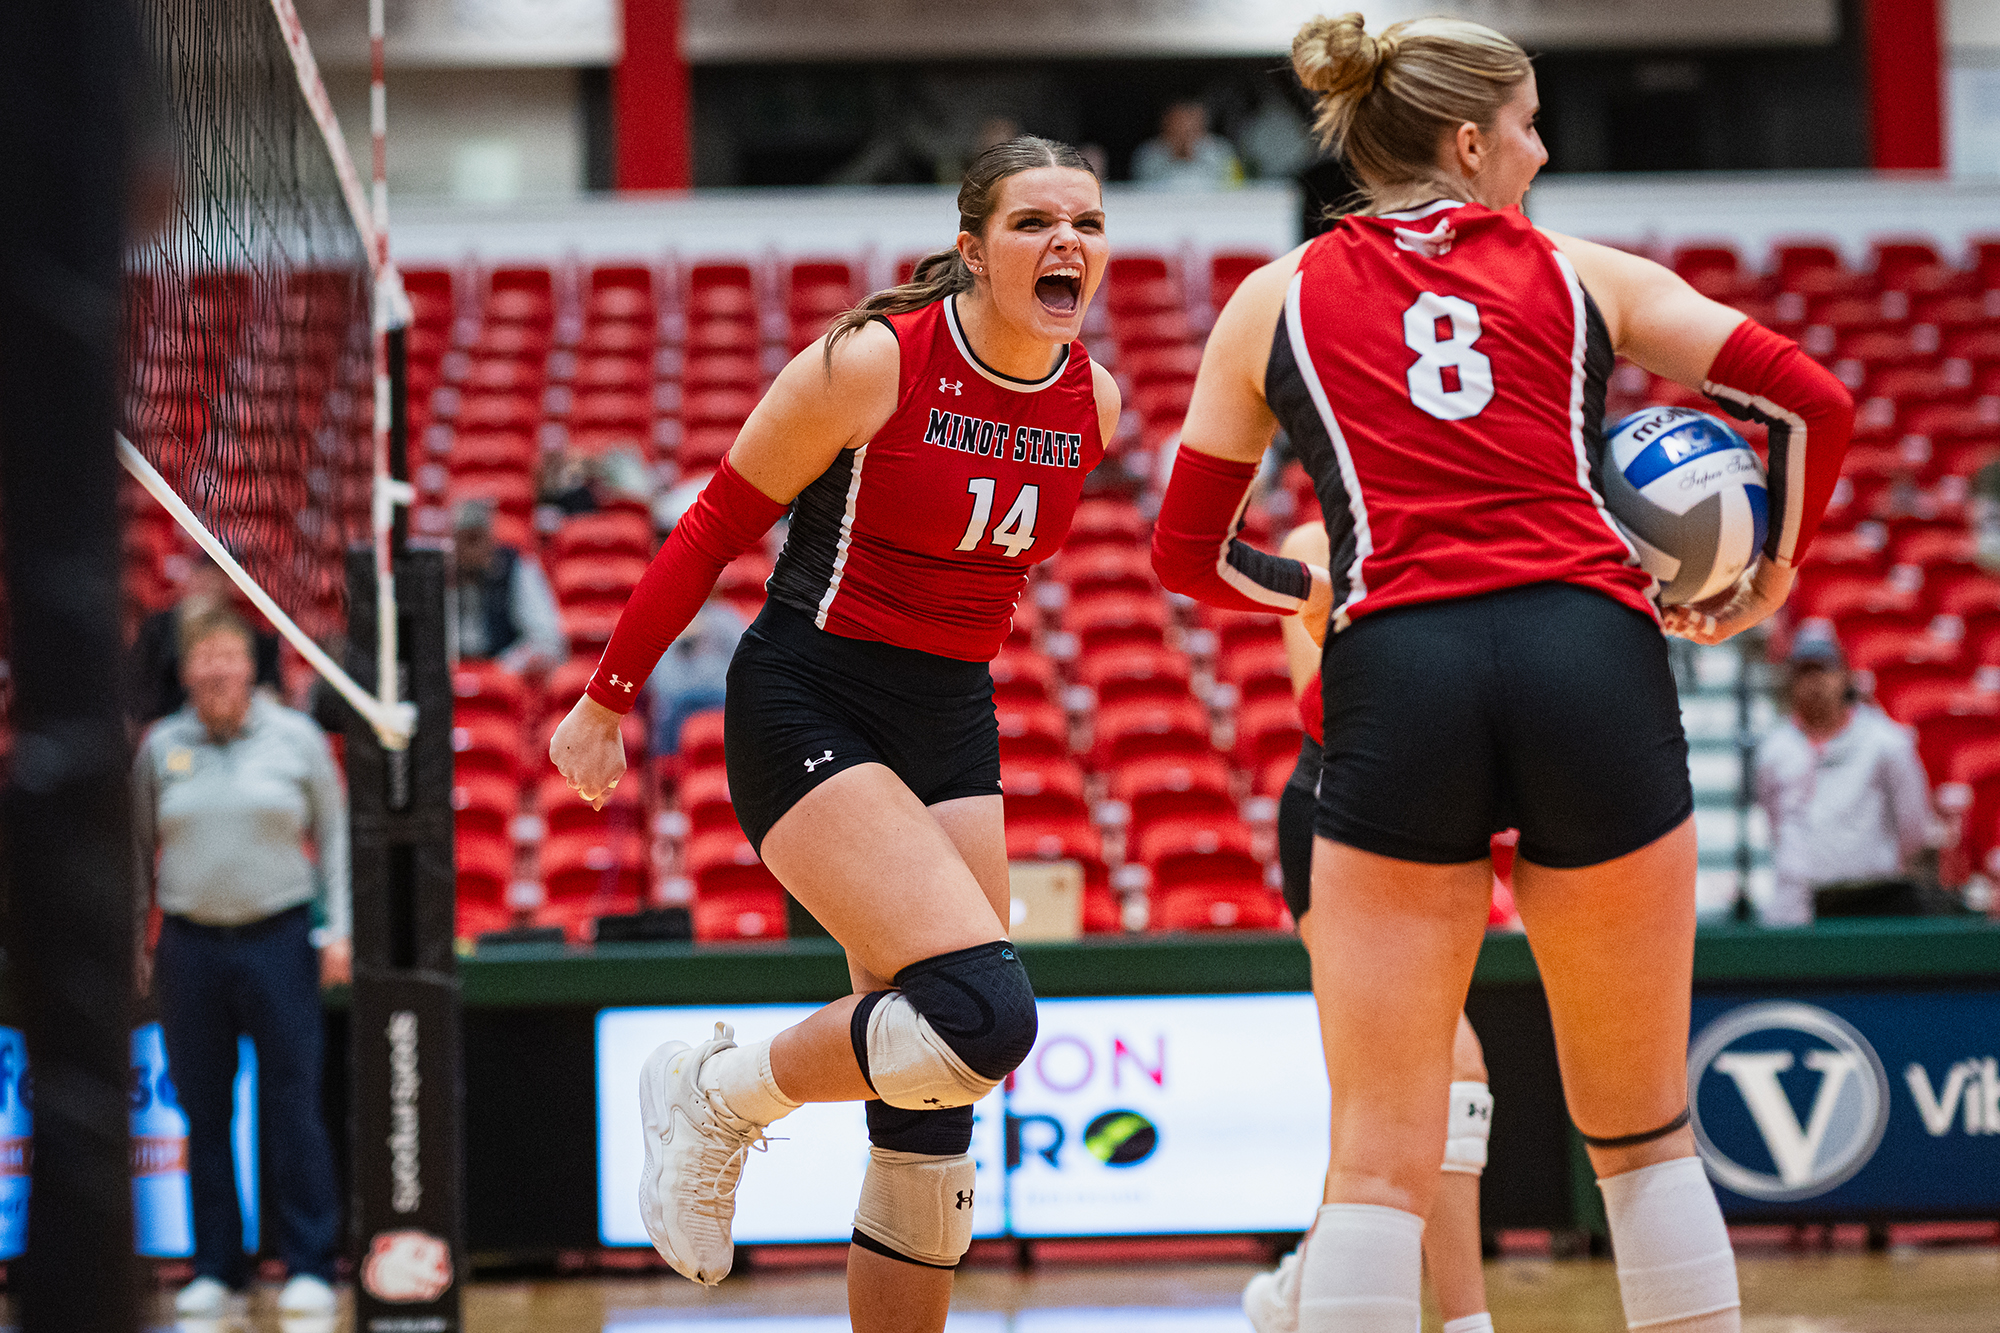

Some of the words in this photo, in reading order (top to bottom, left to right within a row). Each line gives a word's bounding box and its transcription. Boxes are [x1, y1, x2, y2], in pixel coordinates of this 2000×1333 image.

[1403, 292, 1494, 420] 8
[924, 408, 1010, 459] MINOT
[1013, 427, 1081, 468] STATE
[953, 478, 1040, 557] 14
[1714, 1049, 1858, 1187] V
